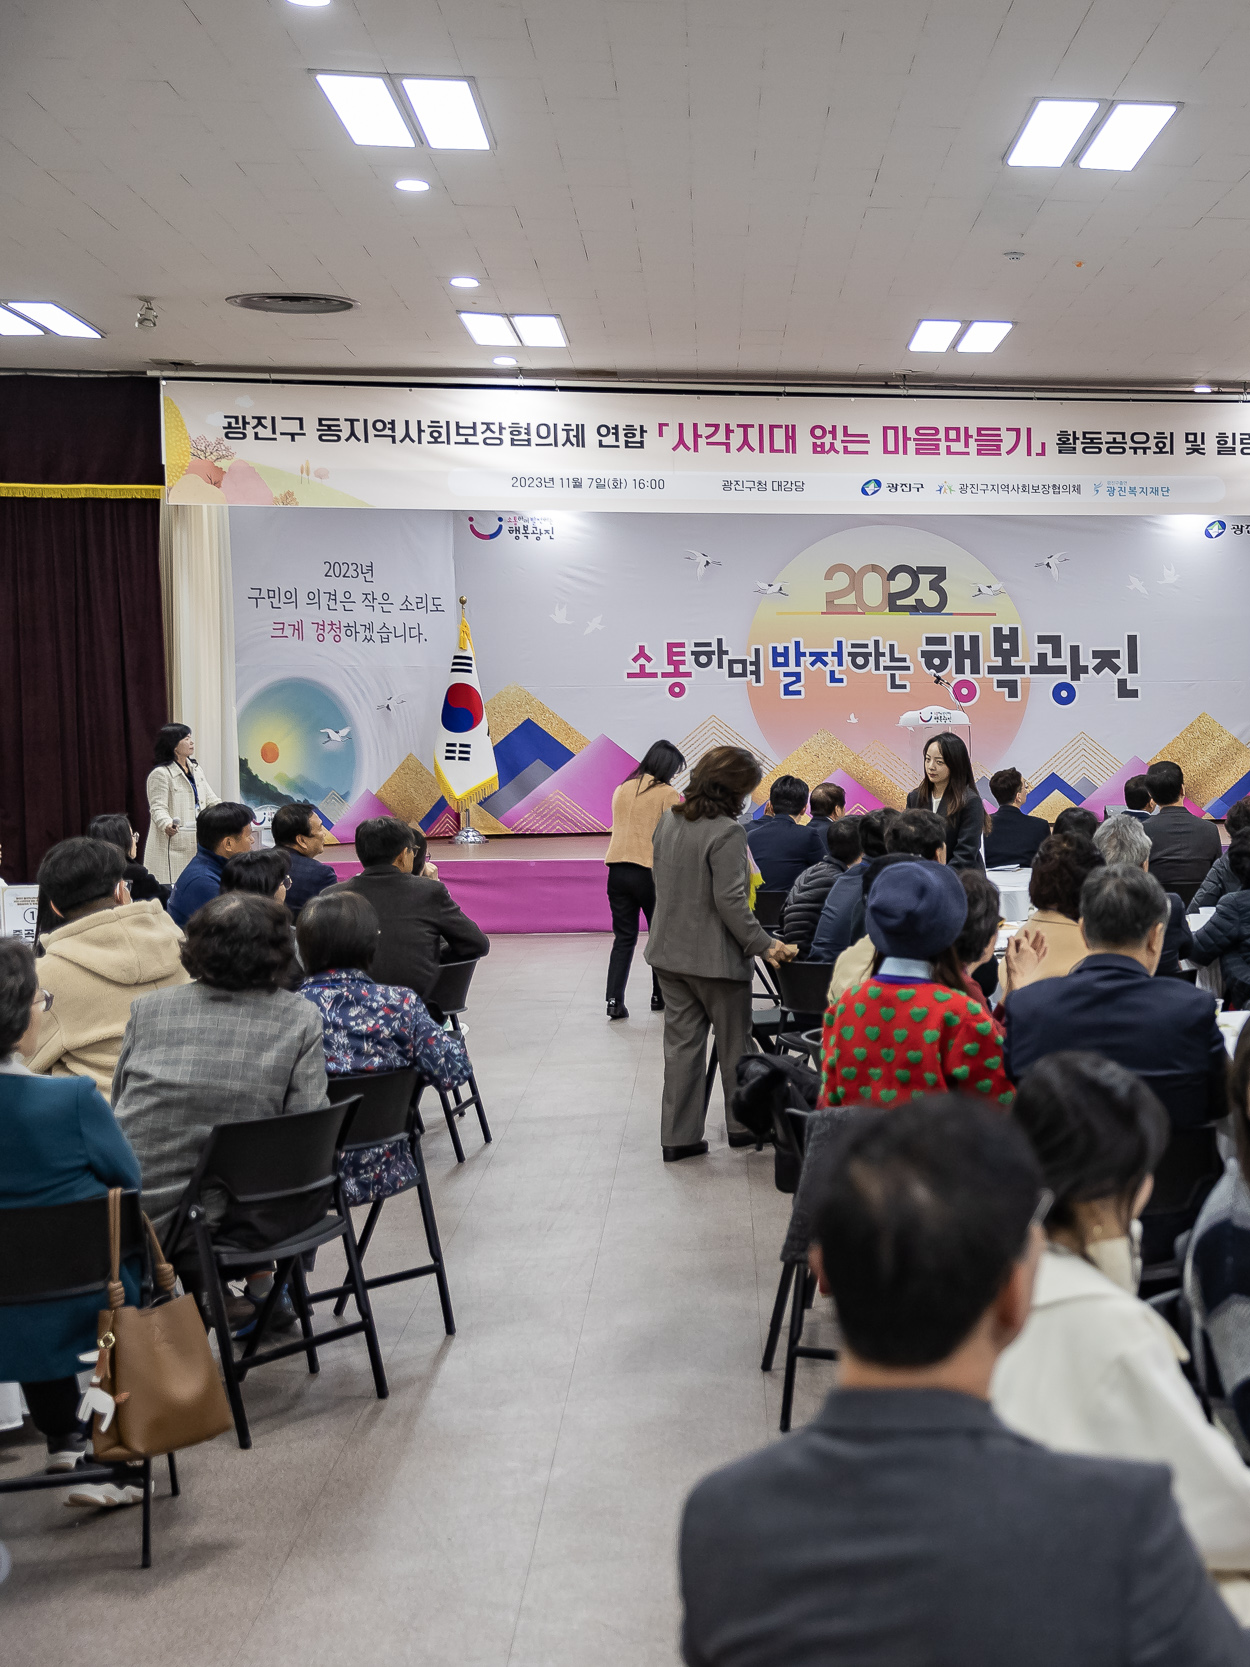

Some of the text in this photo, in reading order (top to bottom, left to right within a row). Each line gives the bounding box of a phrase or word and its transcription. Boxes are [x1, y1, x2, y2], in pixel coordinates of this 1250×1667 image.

[222, 414, 307, 443] 광진구
[316, 416, 586, 448] 동지역사회보장협의체
[596, 423, 648, 449] 연합
[657, 422, 797, 454] 「사각지대
[809, 424, 871, 455] 없는
[882, 425, 1046, 457] 마을만들기」
[1055, 430, 1174, 456] 활동공유회
[1184, 431, 1206, 456] 및
[511, 476, 666, 490] 2023년 11월 7일(화) 16:00
[721, 479, 806, 492] 광진구청 대강당
[885, 482, 925, 493] 광진구
[958, 482, 1082, 495] 광진구지역사회보장협의체
[1106, 486, 1171, 497] 광진복지재단
[508, 524, 555, 541] 행복광진
[323, 560, 375, 583] 2023년
[824, 563, 948, 613] 2023
[247, 586, 446, 615] 구민의 의견은 작은 소리도
[270, 619, 428, 644] 크게 경청하겠습니다.
[626, 626, 1139, 706] 소통하며 발전하는 행복광진
